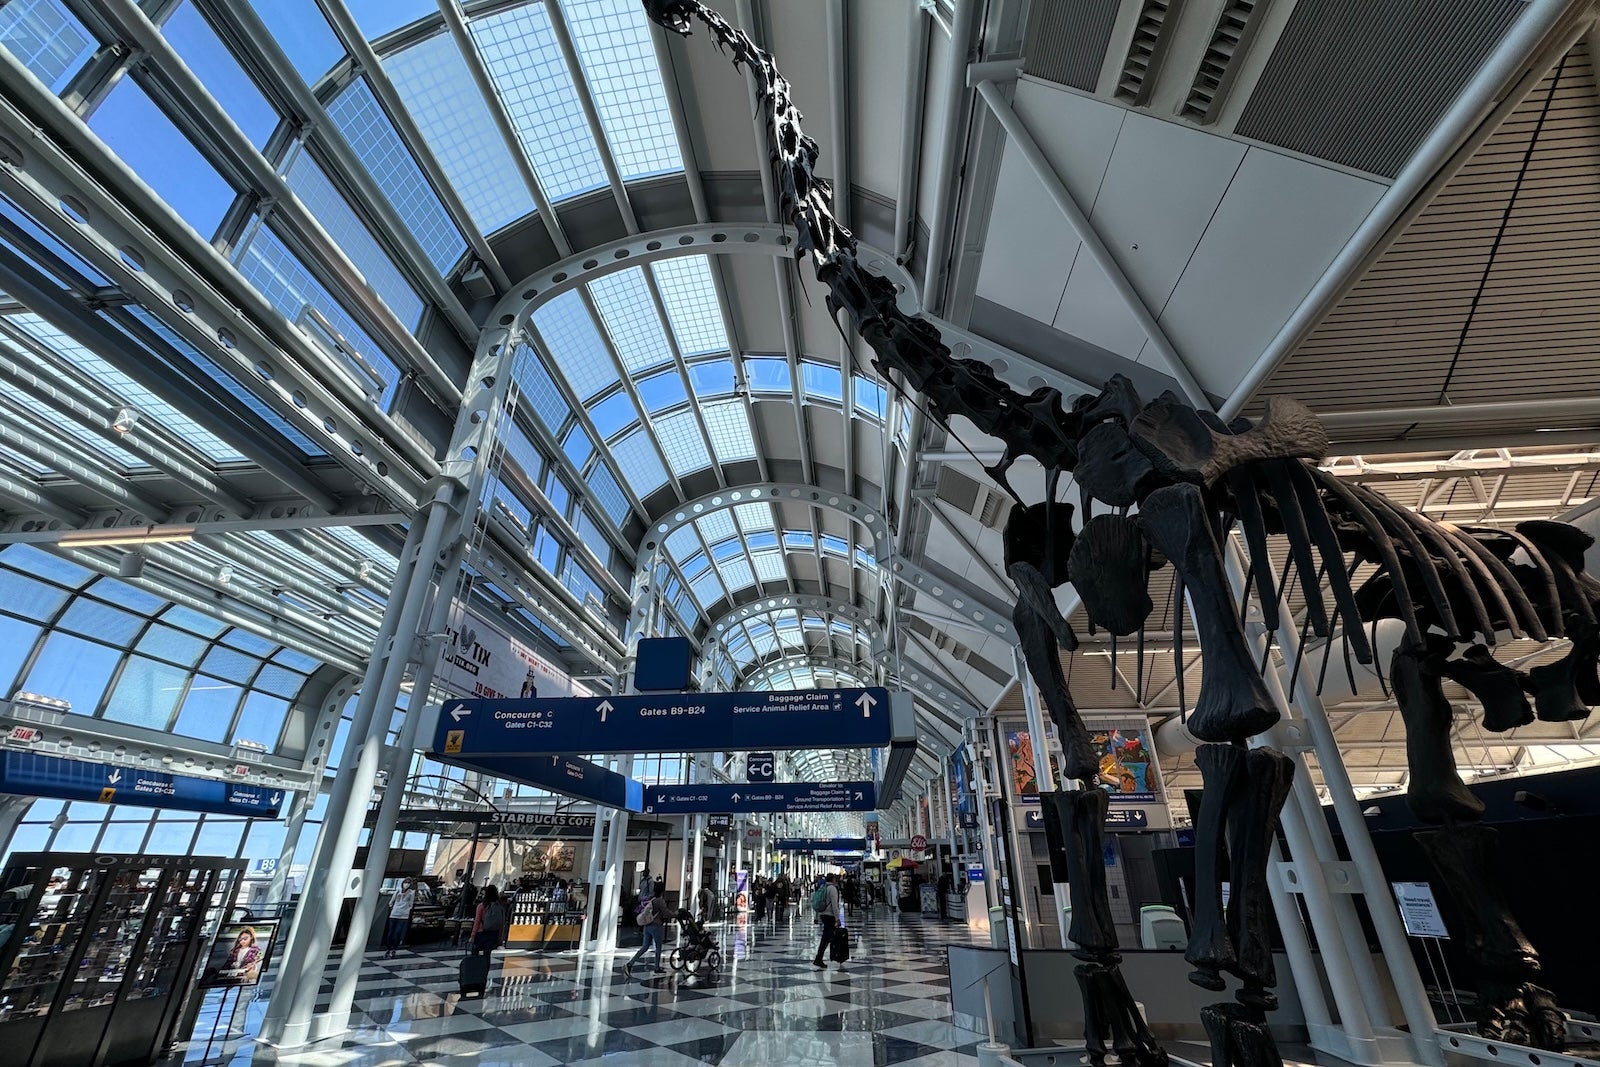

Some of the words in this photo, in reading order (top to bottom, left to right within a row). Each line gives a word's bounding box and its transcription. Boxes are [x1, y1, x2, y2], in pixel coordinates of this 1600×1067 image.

[473, 641, 491, 667] TIX
[475, 682, 482, 694] TO
[484, 685, 496, 698] GIVE
[768, 694, 804, 702] Baggage
[806, 692, 829, 700] Claim
[494, 710, 542, 719] Concourse
[640, 708, 667, 716] Gates
[670, 706, 706, 715] B9-B24
[733, 706, 760, 714] Service
[12, 728, 34, 740] STAIR
[760, 763, 773, 776] C
[137, 778, 168, 788] Concourse
[134, 784, 152, 792] Gates
[154, 786, 176, 795] C1-C32
[492, 812, 566, 825] STARBUCKS
[124, 856, 196, 865] OAKLEY
[261, 859, 276, 870] B9
